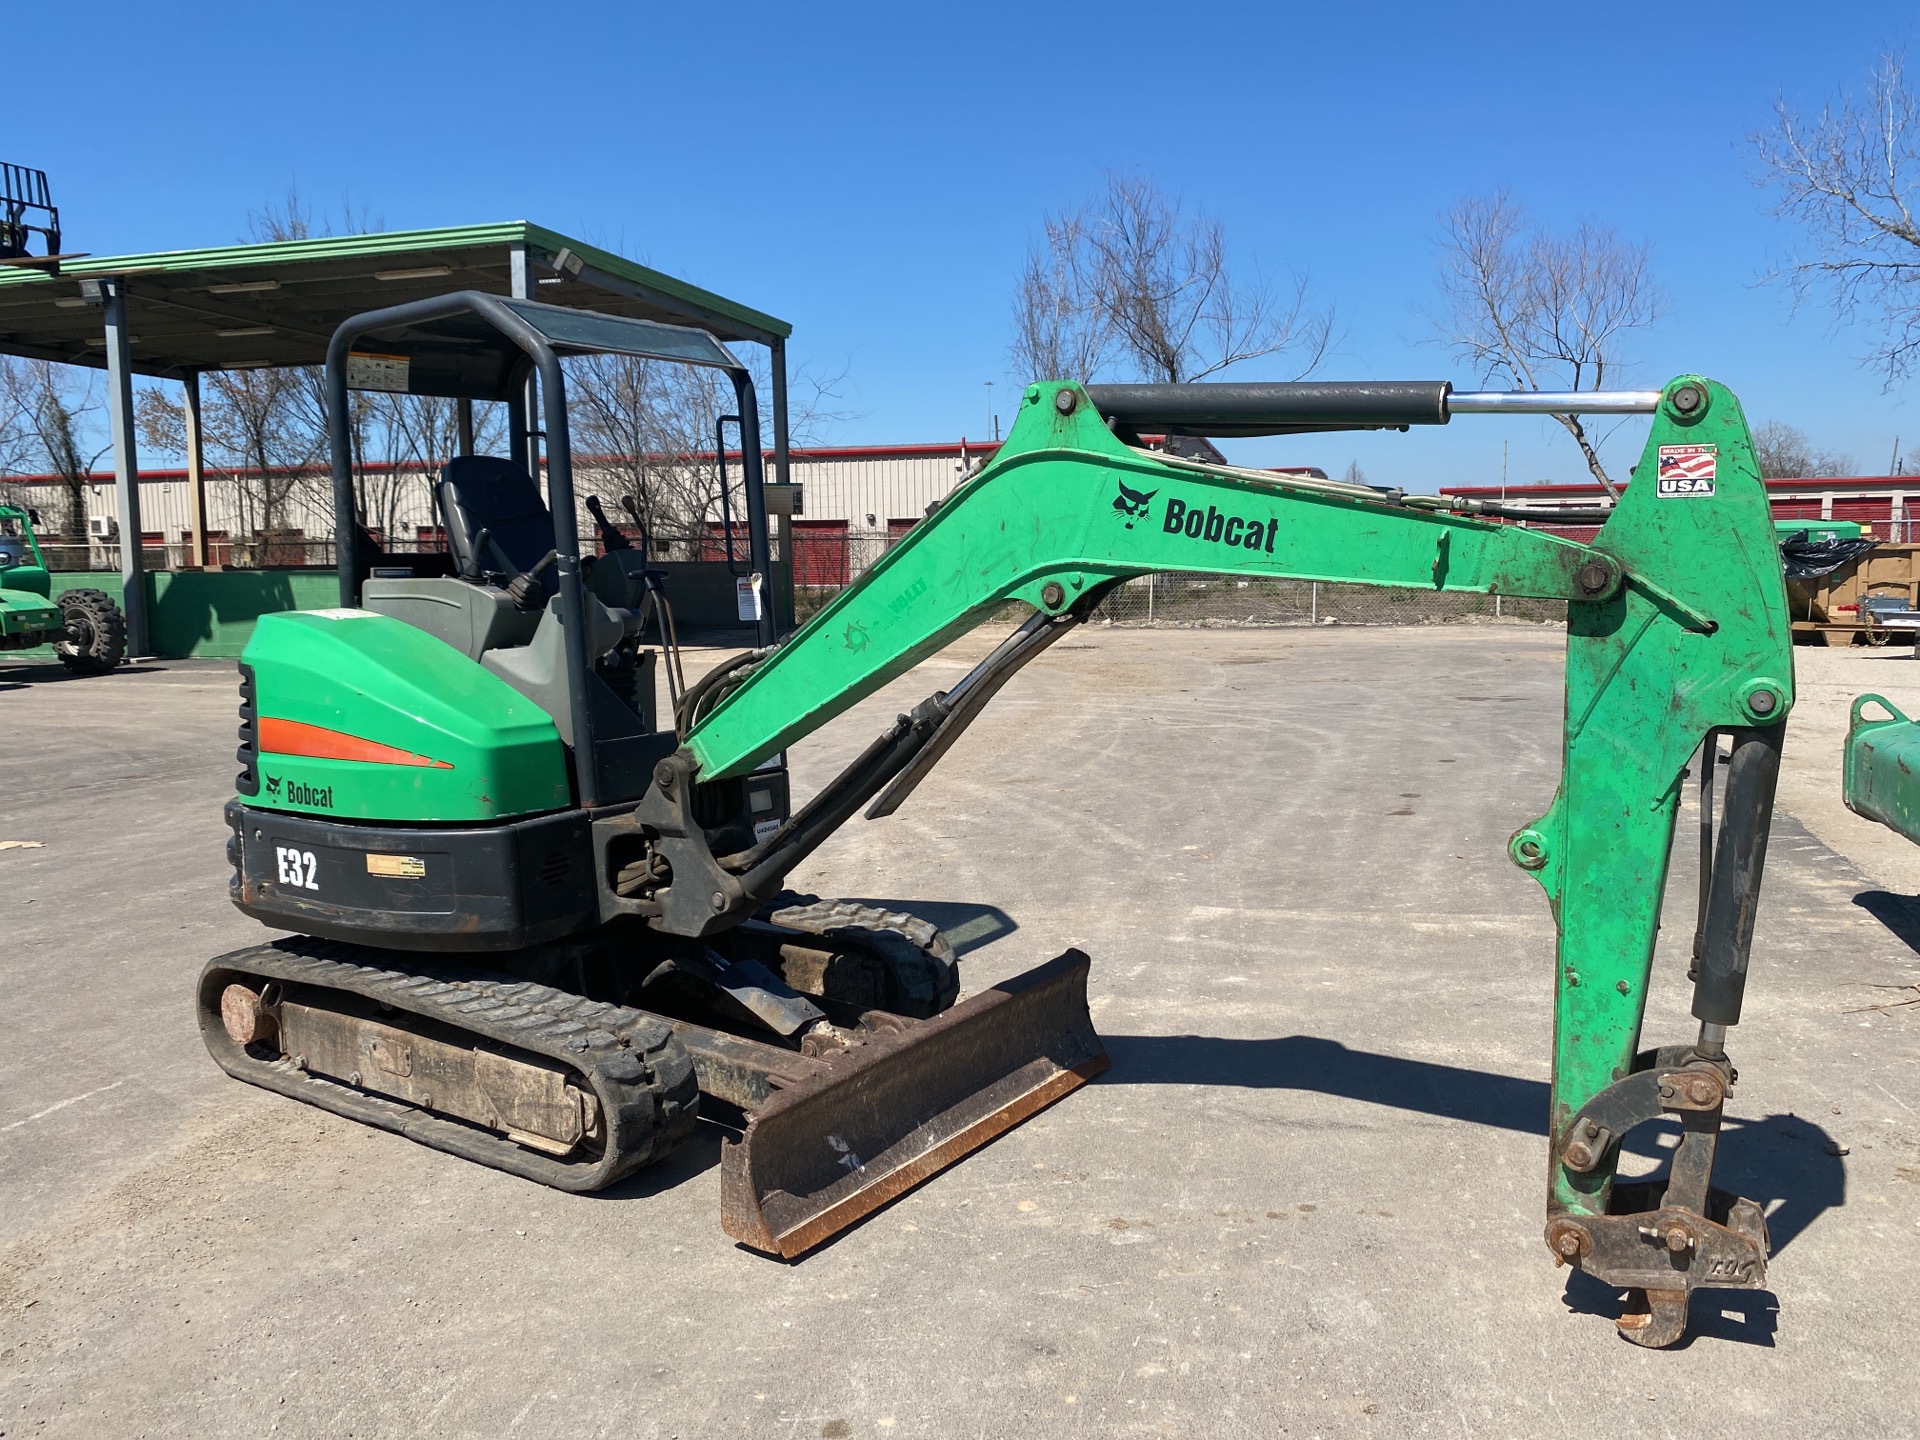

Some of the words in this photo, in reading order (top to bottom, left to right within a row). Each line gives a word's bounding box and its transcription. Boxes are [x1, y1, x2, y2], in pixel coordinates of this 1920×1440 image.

[1661, 479, 1710, 492] USA
[1163, 498, 1279, 553] Bobcat
[287, 780, 333, 808] Bobcat
[276, 846, 319, 890] E32
